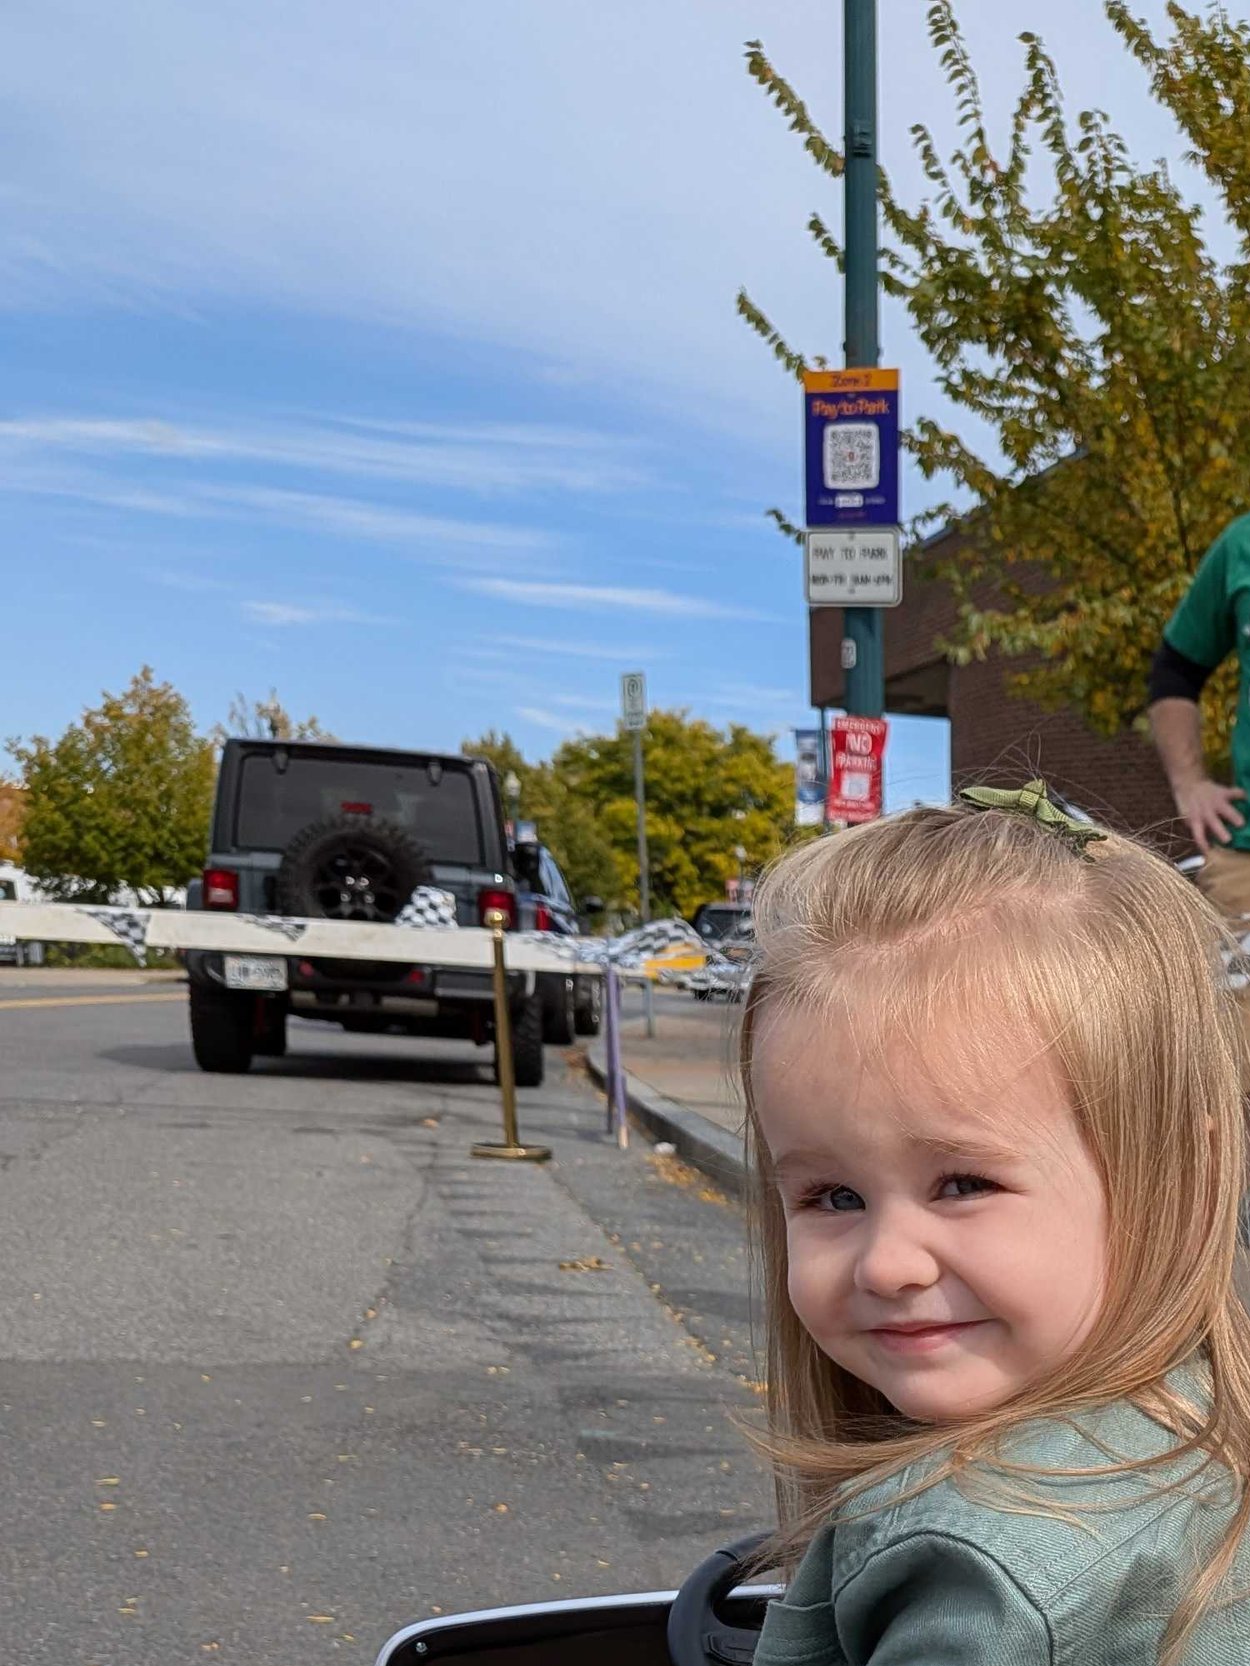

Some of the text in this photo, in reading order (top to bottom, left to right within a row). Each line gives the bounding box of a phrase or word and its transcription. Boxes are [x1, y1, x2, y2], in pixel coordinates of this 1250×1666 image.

[812, 399, 838, 420] Pay
[856, 397, 890, 415] Park
[846, 732, 873, 755] NO
[836, 751, 878, 771] PARKING
